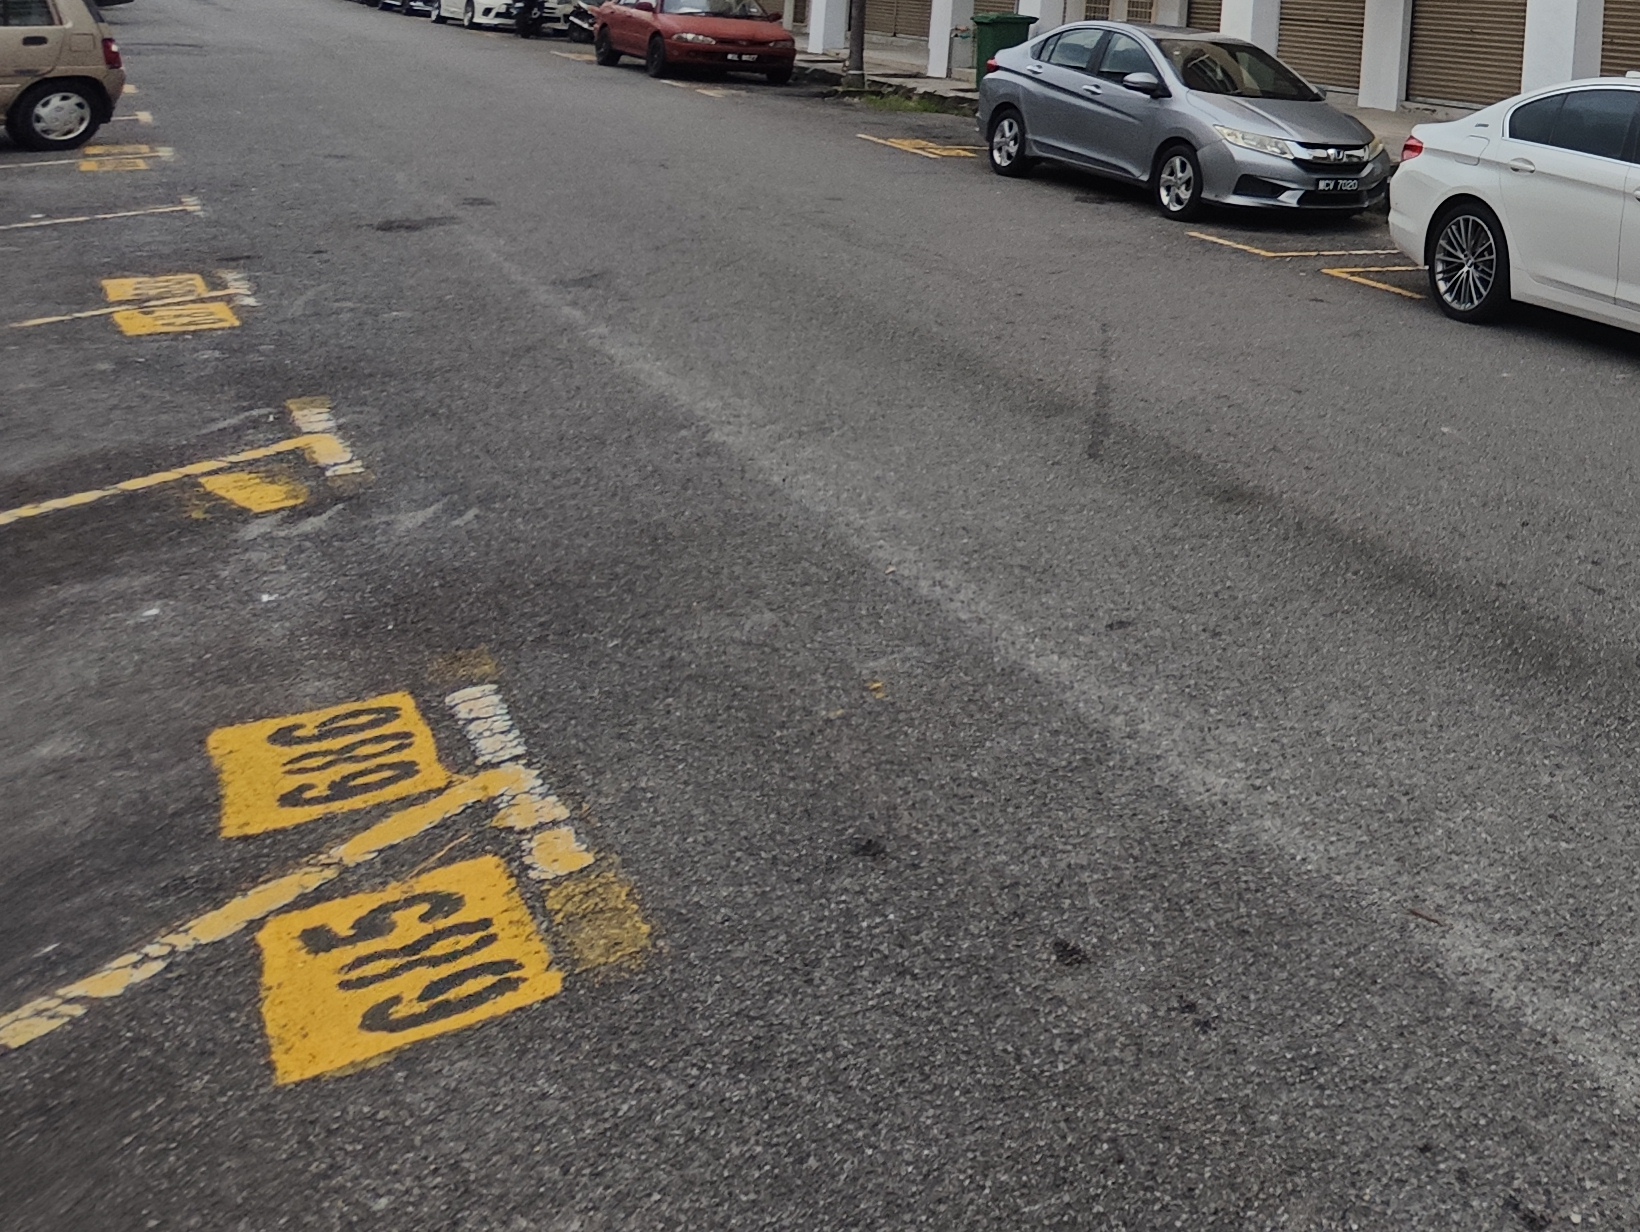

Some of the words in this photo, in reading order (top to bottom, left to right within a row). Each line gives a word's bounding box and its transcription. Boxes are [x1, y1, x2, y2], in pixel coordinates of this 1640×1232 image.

[1337, 179, 1358, 191] 7020
[265, 705, 421, 810] 686
[294, 889, 529, 1035] 685
